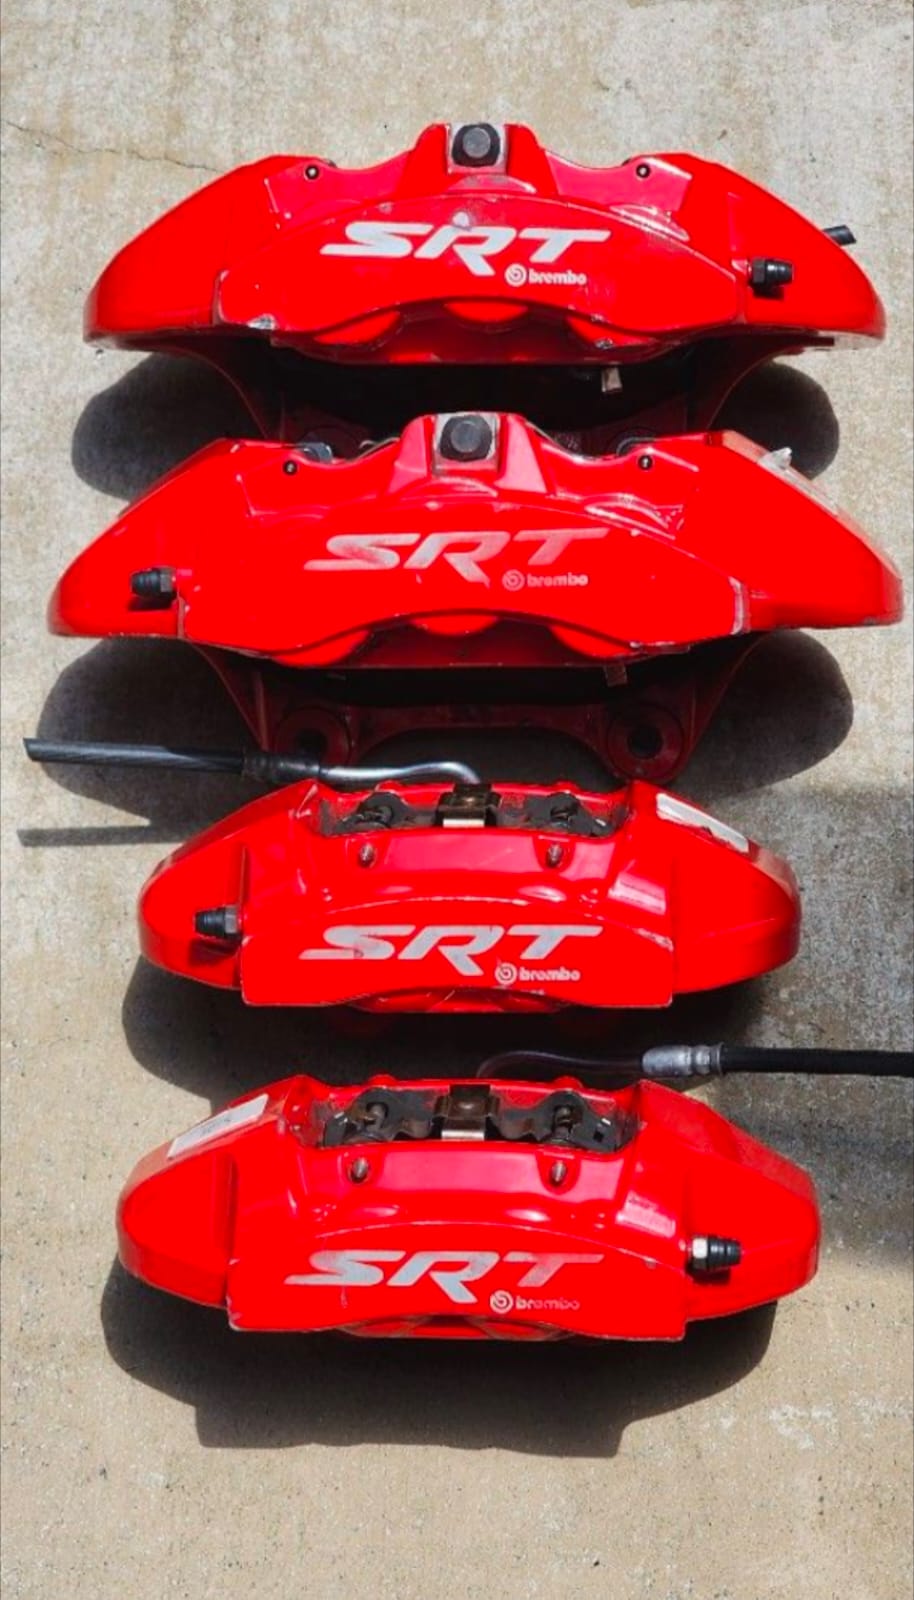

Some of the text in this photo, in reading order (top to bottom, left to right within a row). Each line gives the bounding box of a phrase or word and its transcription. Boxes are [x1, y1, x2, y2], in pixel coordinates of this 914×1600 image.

[319, 221, 611, 276] SRT
[528, 268, 587, 285] brembo
[303, 527, 610, 583] SRT
[526, 572, 588, 587] brembo
[299, 925, 603, 976] SRT
[284, 1249, 605, 1303] SRT
